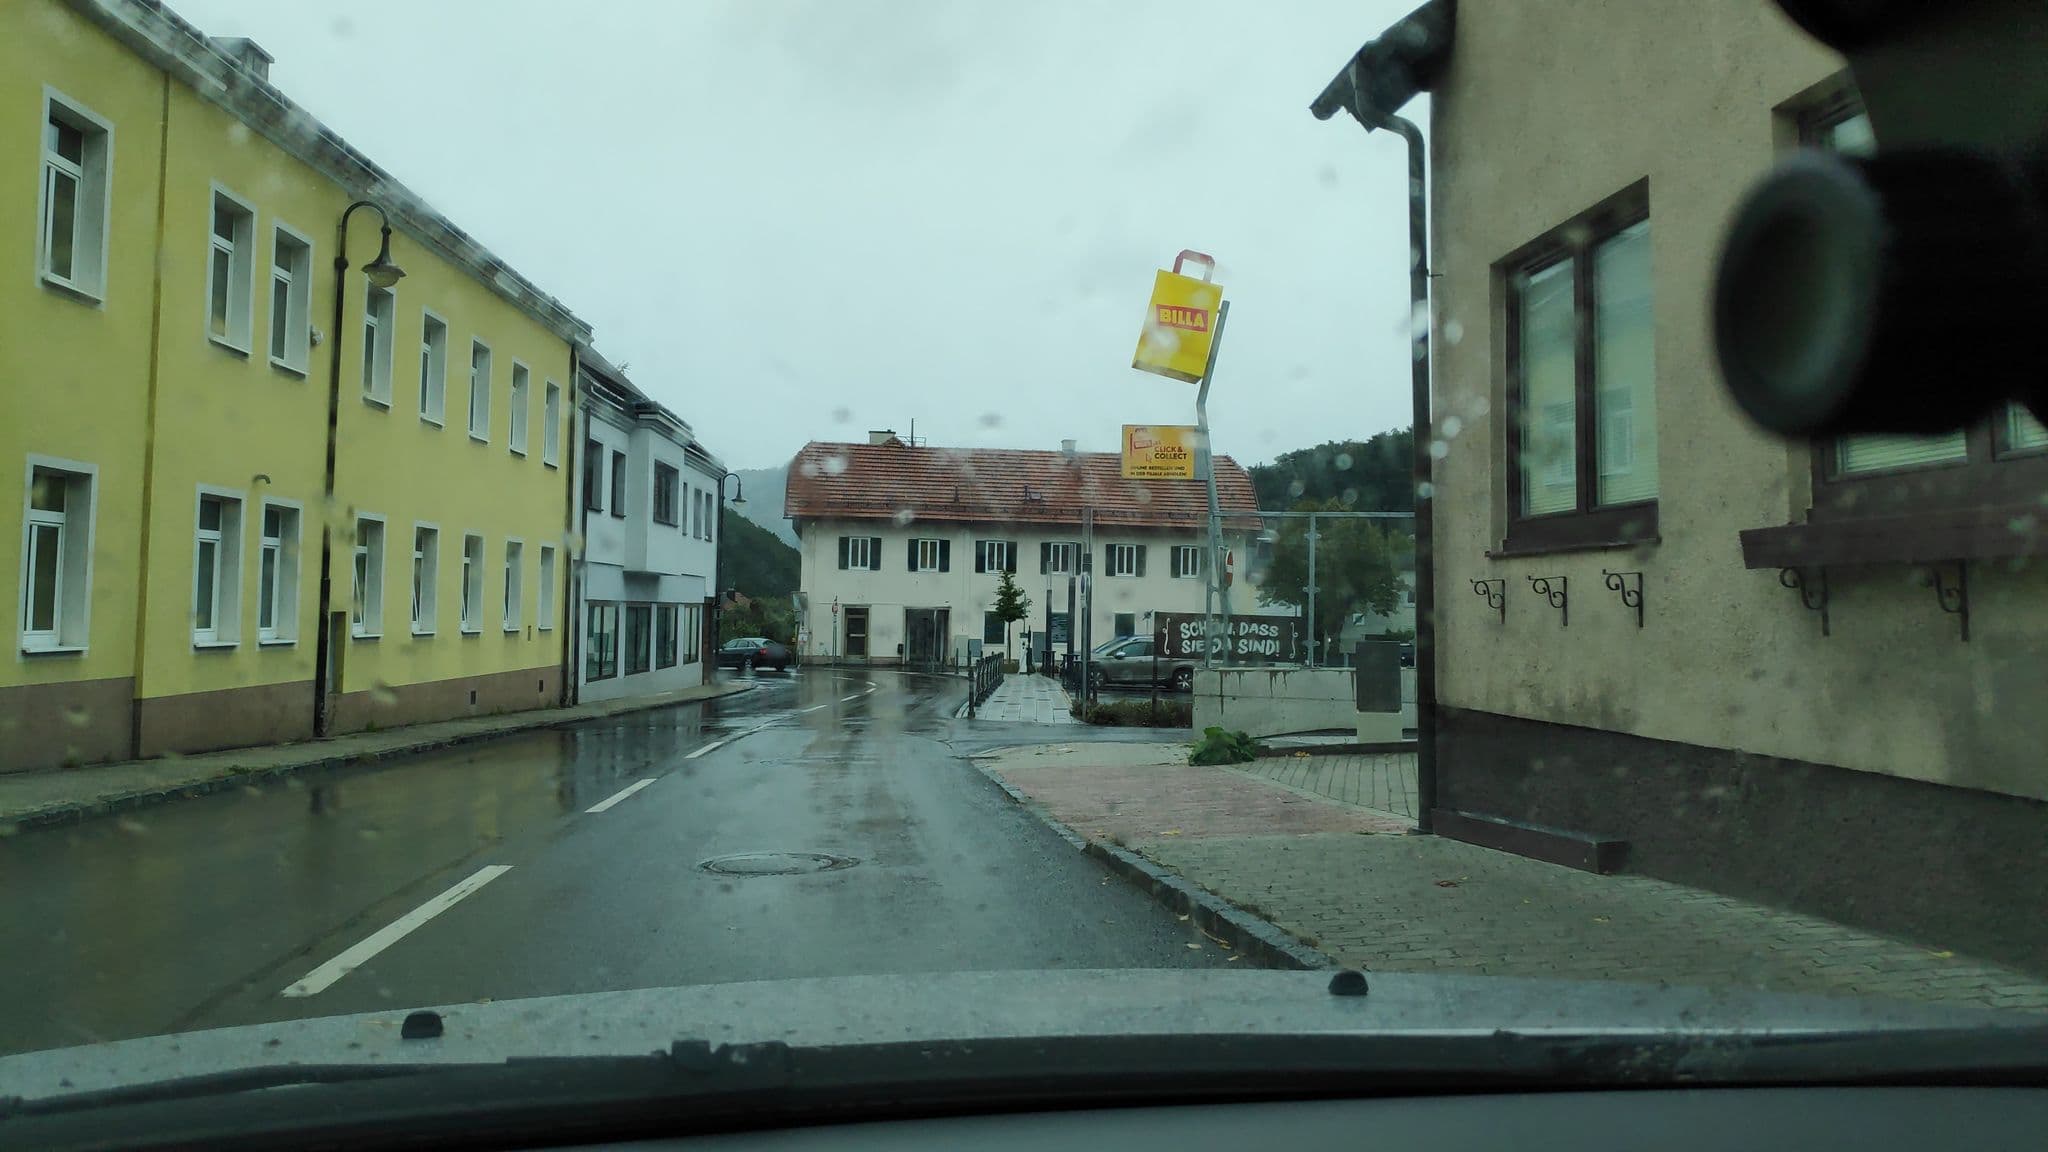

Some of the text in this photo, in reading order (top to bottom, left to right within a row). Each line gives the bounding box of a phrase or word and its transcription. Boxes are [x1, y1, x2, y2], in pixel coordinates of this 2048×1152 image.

[1159, 308, 1205, 327] BILLA
[1239, 622, 1280, 637] DASS
[1181, 639, 1206, 654] SIE
[1237, 638, 1280, 657] SIND!
